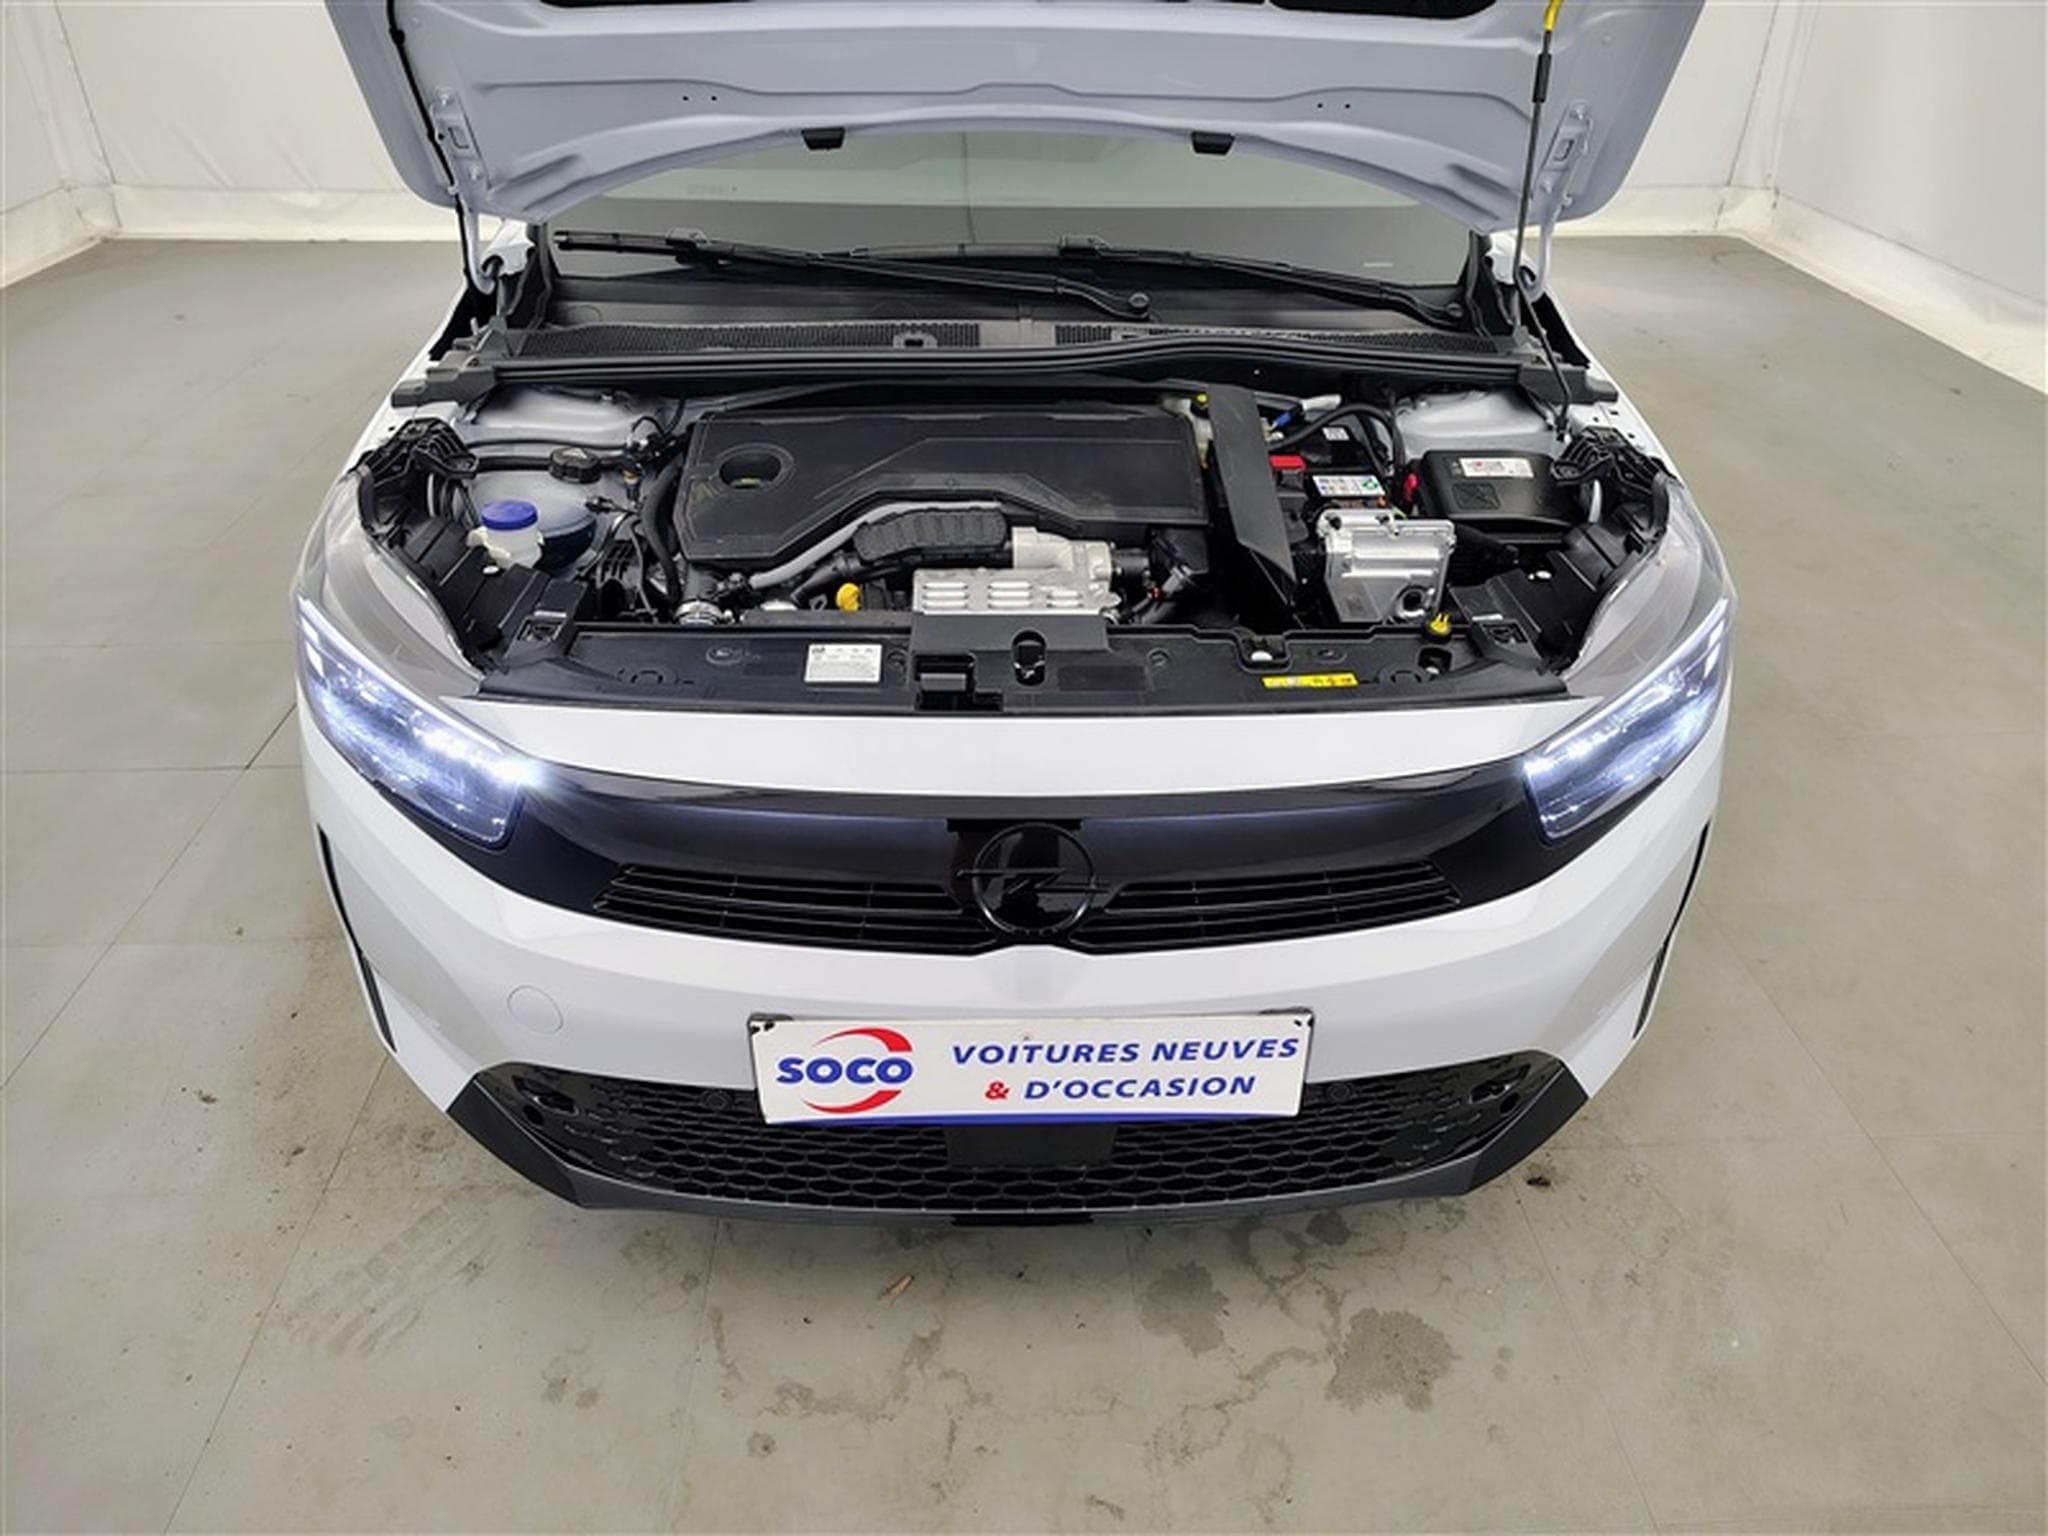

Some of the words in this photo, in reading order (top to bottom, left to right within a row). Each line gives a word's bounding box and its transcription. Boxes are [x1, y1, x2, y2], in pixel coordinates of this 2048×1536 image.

[952, 1042, 1139, 1066] VOITURES
[1151, 1038, 1299, 1062] NEUVES
[776, 1056, 914, 1087] SOCO
[984, 1081, 1009, 1101] &
[1023, 1076, 1256, 1101] D'OCCASION
